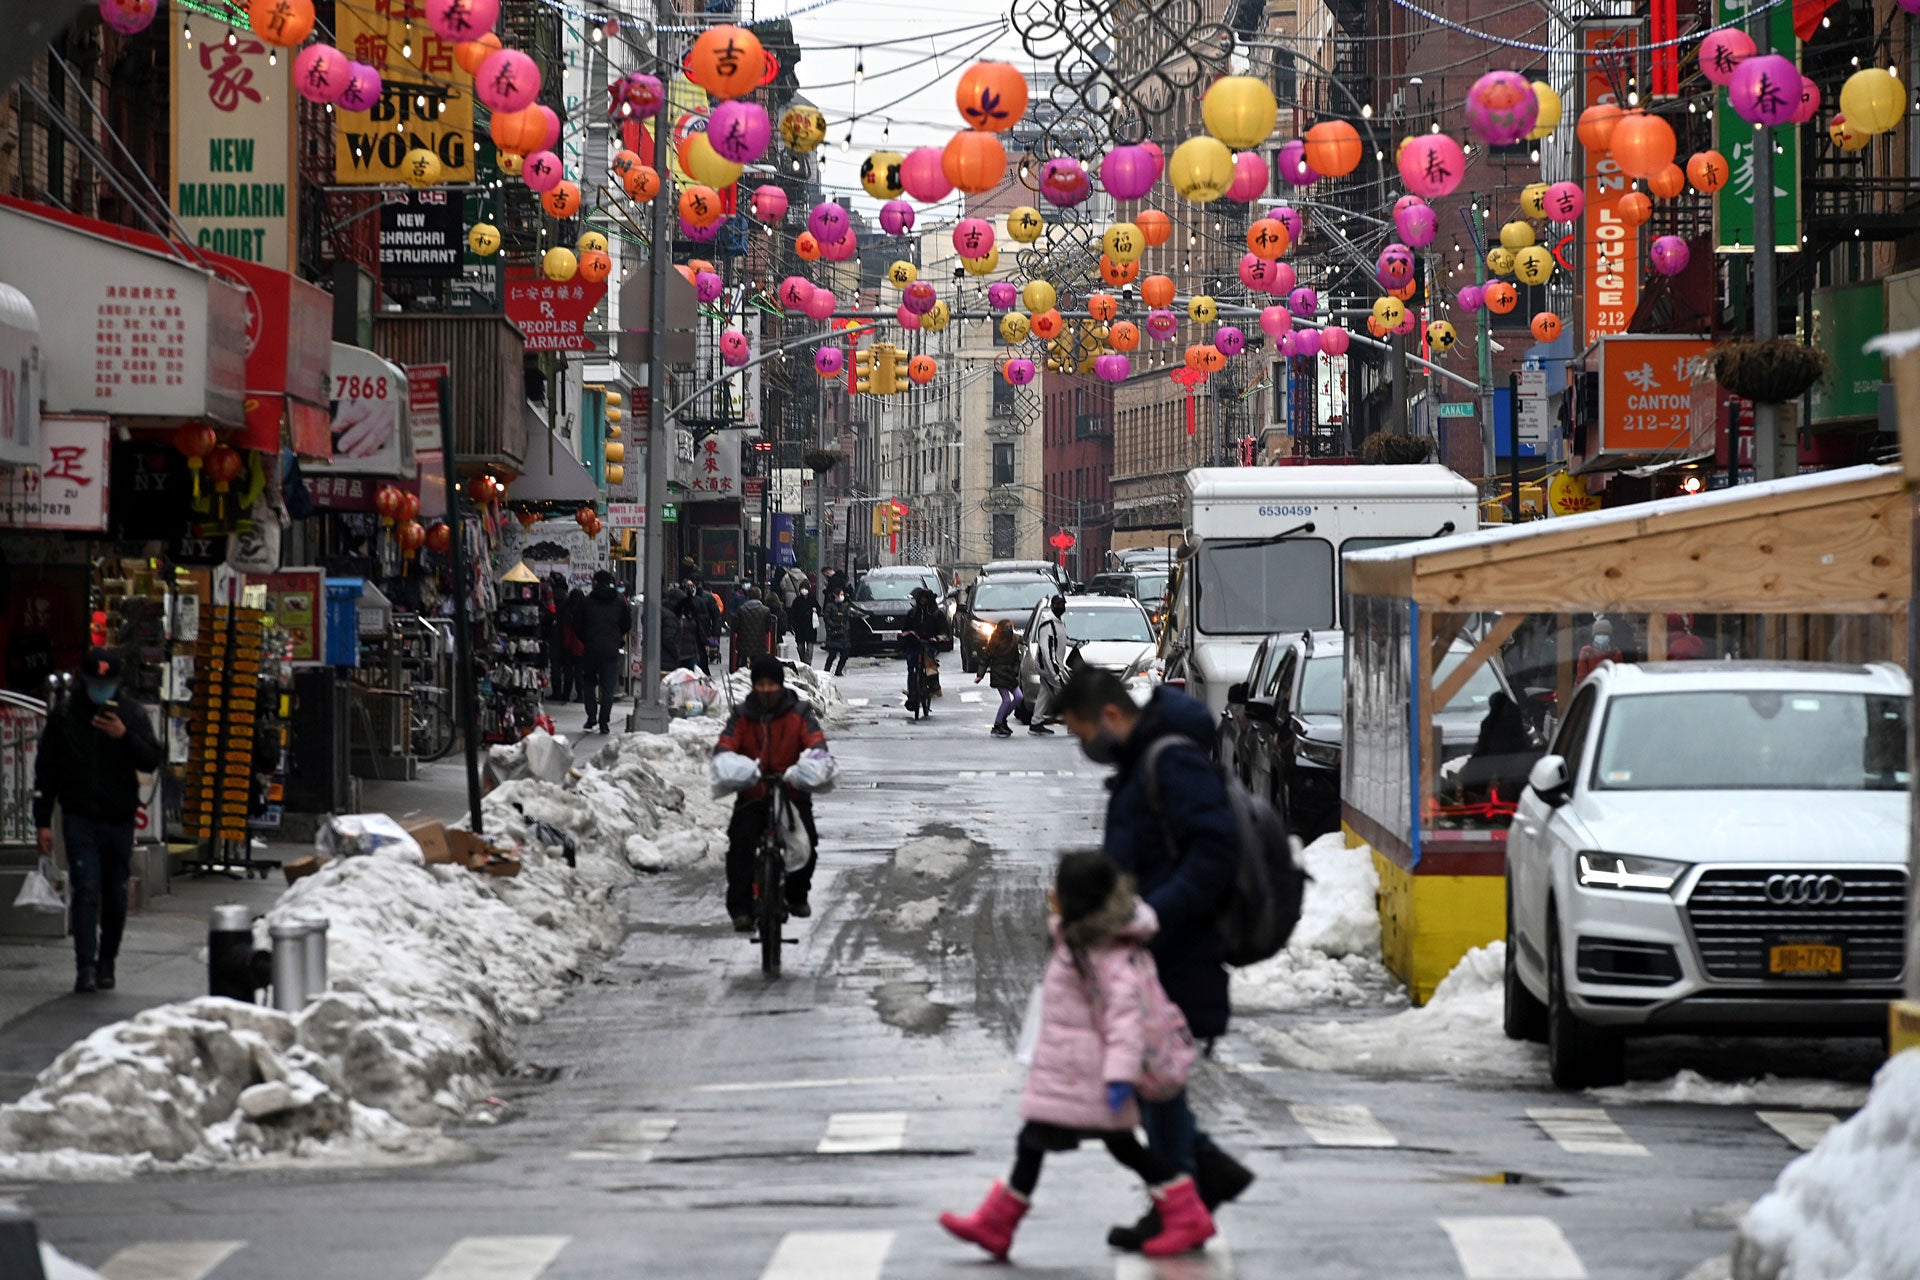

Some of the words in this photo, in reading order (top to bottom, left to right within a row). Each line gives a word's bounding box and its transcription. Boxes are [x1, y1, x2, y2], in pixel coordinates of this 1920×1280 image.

[441, 0, 472, 31] 春
[354, 32, 453, 74] 飯店
[714, 38, 744, 76] 吉
[1714, 45, 1740, 73] 春
[307, 56, 330, 89] 春
[490, 60, 517, 97] 春
[371, 85, 441, 122] BIG
[1752, 72, 1787, 115] 春
[722, 119, 749, 157] 春
[209, 138, 254, 173] NEW
[345, 131, 465, 169] WONG
[412, 157, 430, 176] 吉
[530, 159, 551, 176] 和
[1424, 149, 1451, 184] 春
[1702, 161, 1719, 186] 貴
[179, 183, 285, 217] MANDARIN
[552, 189, 570, 210] 吉
[690, 194, 708, 217] 吉
[1556, 191, 1576, 213] 吉
[397, 213, 426, 227] NEW
[819, 214, 839, 225] 和
[1020, 214, 1038, 228] 和
[197, 228, 265, 263] COURT
[379, 231, 445, 245] SHANGHAI
[476, 236, 492, 248] 和
[964, 226, 982, 249] 吉
[1112, 231, 1133, 253] 福
[1255, 229, 1279, 249] 和
[379, 250, 457, 263] ESTAURANT
[590, 258, 606, 271] 和
[1522, 255, 1540, 277] 吉
[1595, 208, 1626, 306] LOUNGE
[893, 266, 908, 282] 福
[1248, 259, 1267, 280] 吉
[1496, 293, 1513, 307] 和
[518, 320, 577, 333] PEOPLES
[1539, 319, 1555, 332] 和
[1598, 311, 1625, 326] 212
[523, 335, 585, 348] ARMACY
[914, 363, 929, 374] 和
[336, 376, 387, 399] 7868
[1440, 404, 1466, 417] CANAL
[1628, 394, 1691, 410] CANTON
[43, 446, 92, 487] 足
[134, 473, 168, 491] NY
[692, 476, 733, 491] 大酒家
[1258, 506, 1312, 517] 6530459
[181, 538, 212, 557] NY
